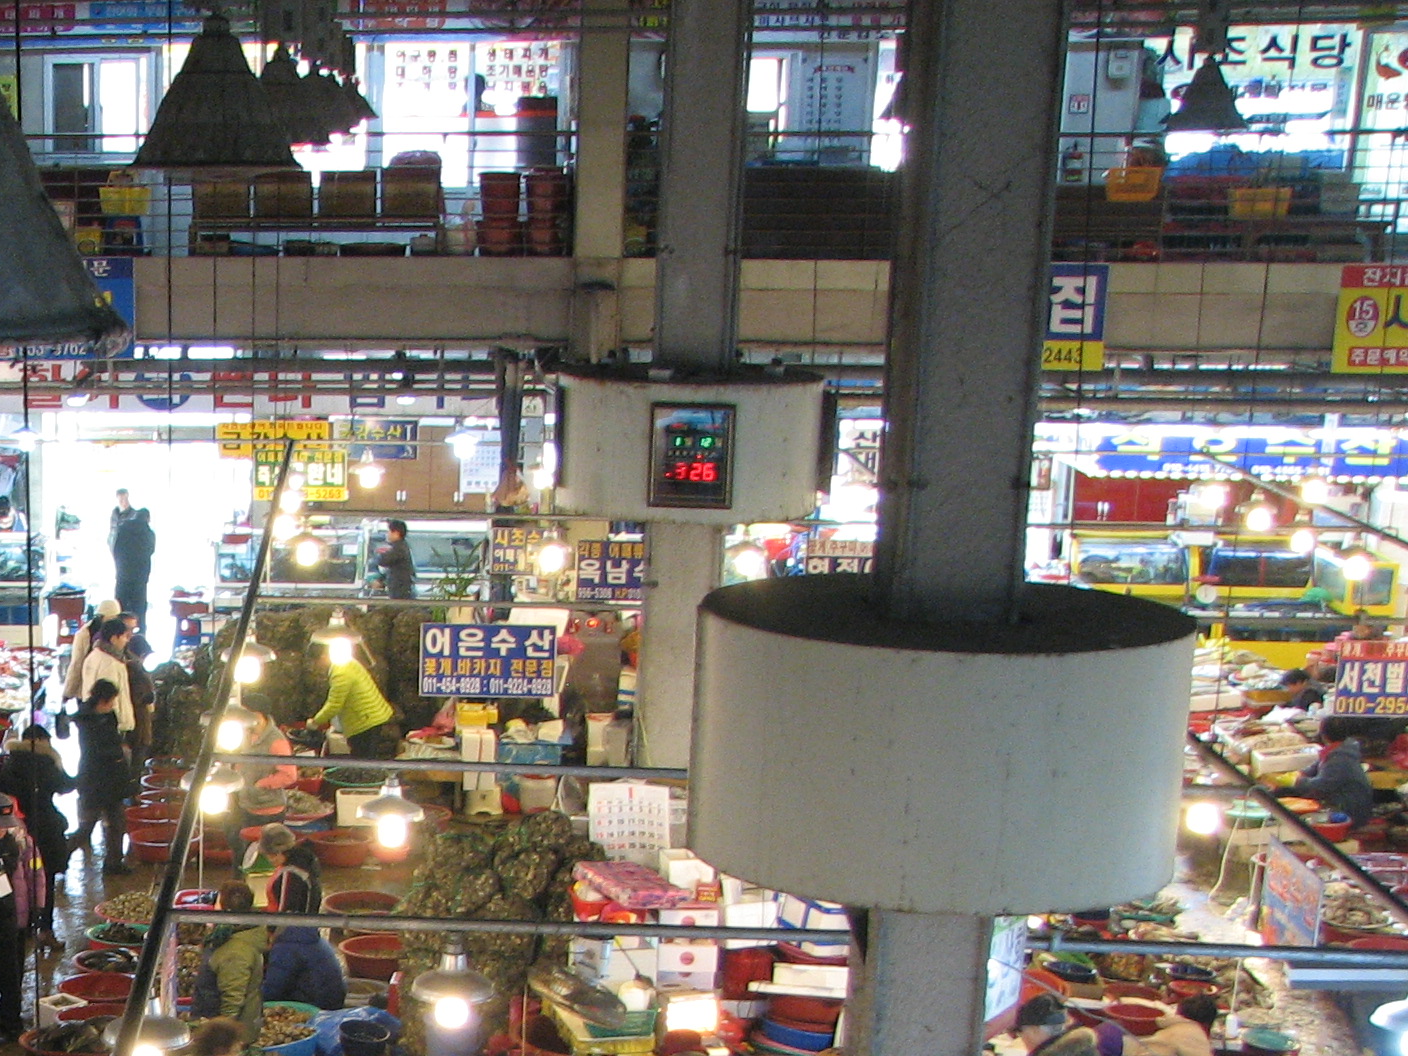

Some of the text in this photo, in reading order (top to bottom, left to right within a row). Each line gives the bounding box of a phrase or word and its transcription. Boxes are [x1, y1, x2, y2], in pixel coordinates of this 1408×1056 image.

[1352, 299, 1375, 321] 15
[424, 627, 554, 658] 어은수산
[1336, 695, 1408, 714] 010-295
